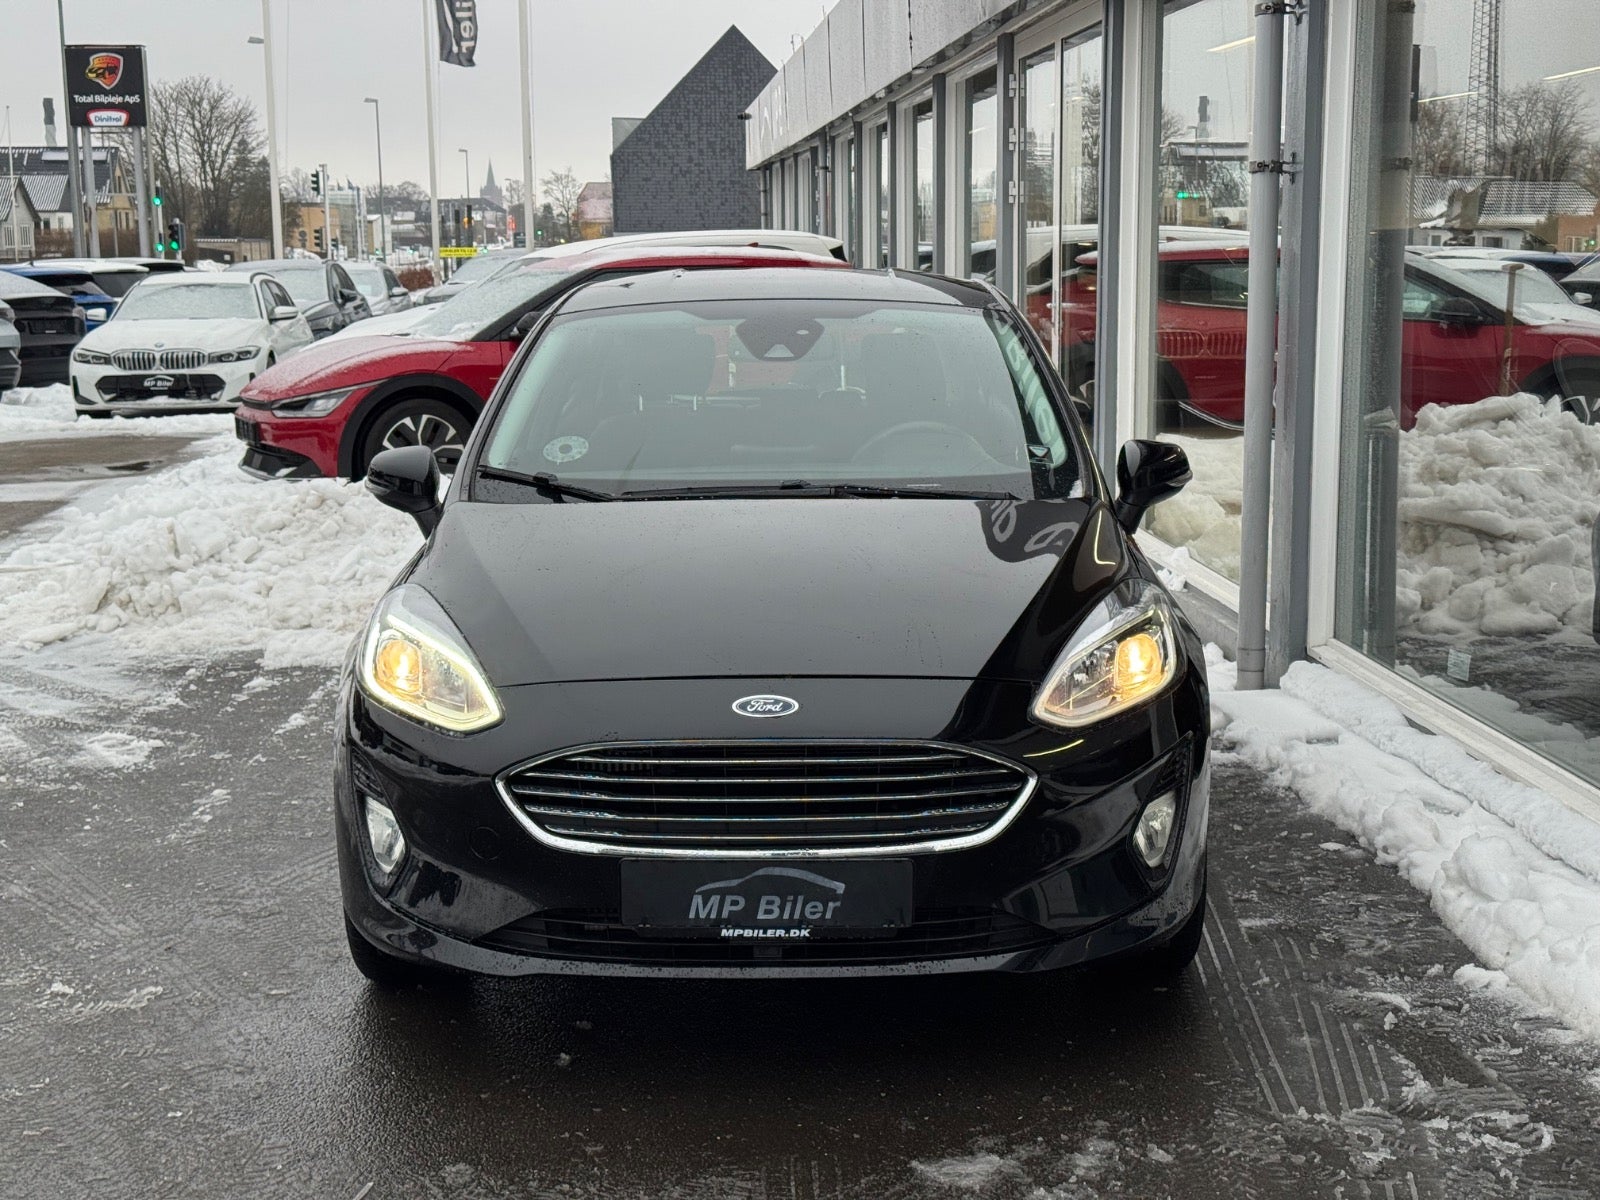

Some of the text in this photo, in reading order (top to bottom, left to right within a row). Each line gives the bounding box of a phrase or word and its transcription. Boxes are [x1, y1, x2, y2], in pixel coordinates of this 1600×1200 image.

[73, 94, 140, 104] Total Bilpleje ApS
[94, 115, 122, 123] Dinitrol
[747, 699, 783, 712] Ford
[688, 894, 842, 920] MP Biler
[720, 928, 811, 938] MPBILER.DK
